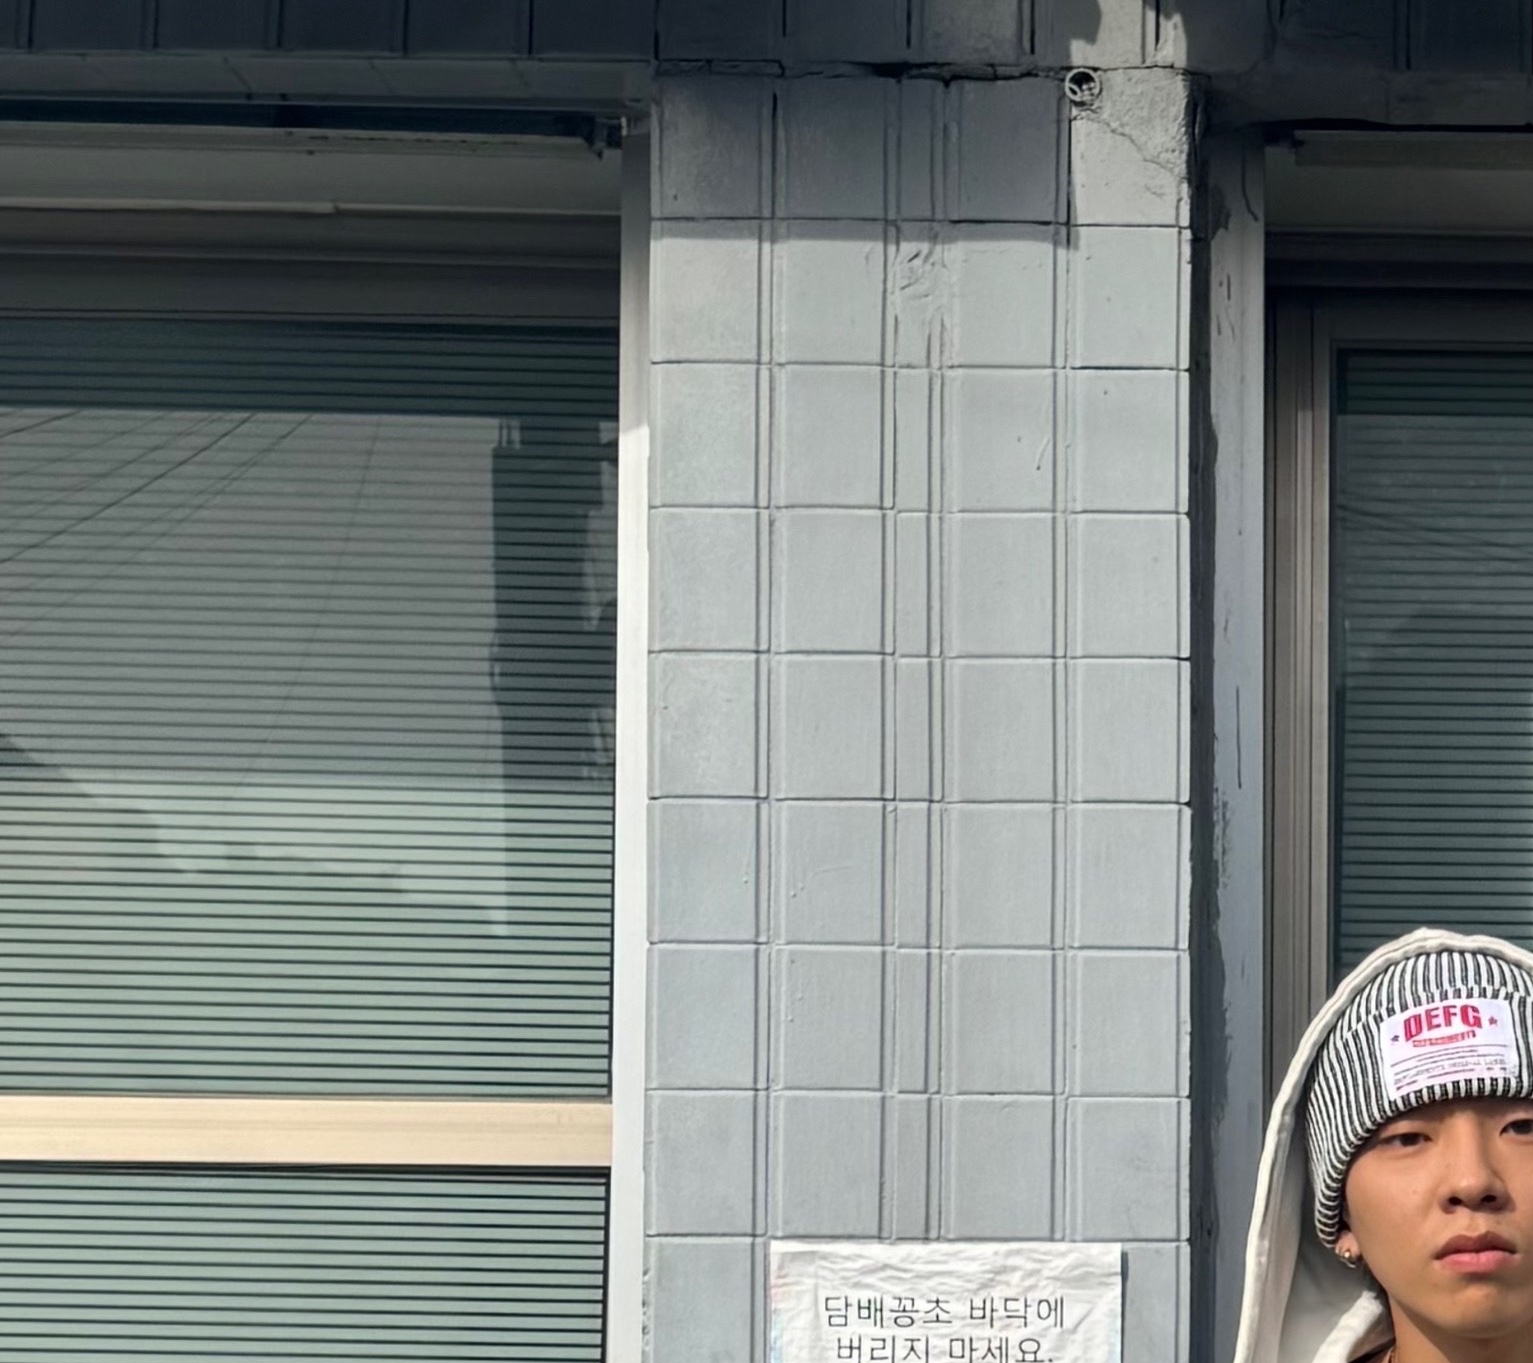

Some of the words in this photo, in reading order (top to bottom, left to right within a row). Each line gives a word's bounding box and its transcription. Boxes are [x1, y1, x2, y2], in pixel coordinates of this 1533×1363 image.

[1404, 1003, 1483, 1042] DEFG
[825, 1295, 952, 1328] 담배꽁초
[970, 1295, 1064, 1329] 바닥에
